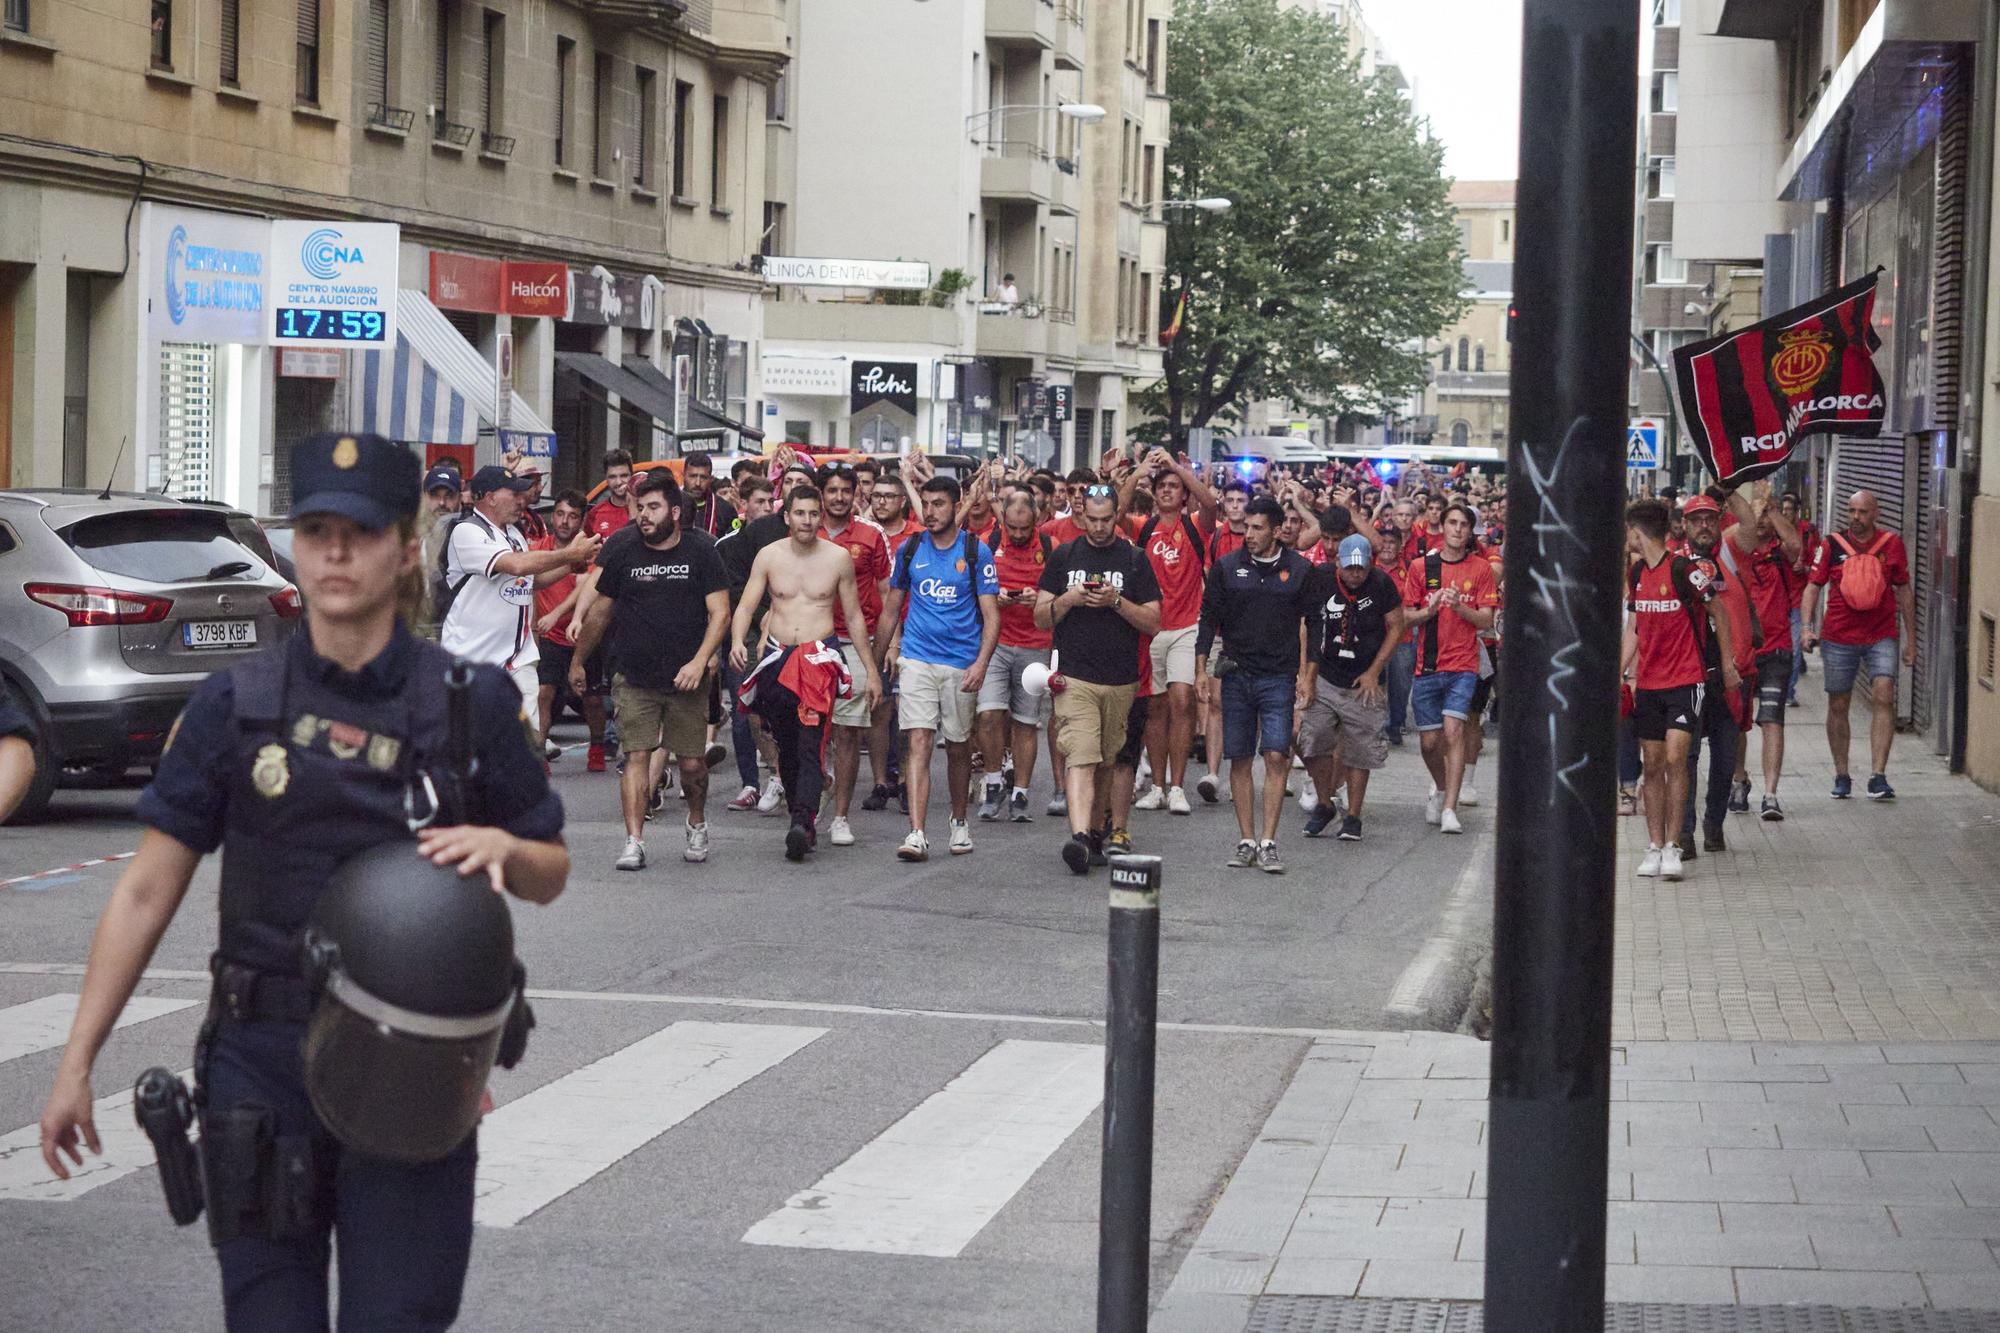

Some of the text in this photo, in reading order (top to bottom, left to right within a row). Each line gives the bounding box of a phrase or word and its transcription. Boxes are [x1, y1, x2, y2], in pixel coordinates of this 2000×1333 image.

[319, 247, 363, 263] CNA
[819, 265, 873, 280] DENTAL
[289, 284, 377, 294] CENTRO NAVARRO
[512, 275, 560, 297] Halcón
[289, 295, 377, 305] DE LA AUDICION
[283, 310, 381, 338] 17:59
[767, 368, 835, 376] EMPANADAS
[765, 379, 836, 387] ARGENTINAS
[1741, 394, 1883, 453] RCD MALLORCA
[630, 564, 690, 578] mallorca
[196, 623, 249, 641] 3798 KBF
